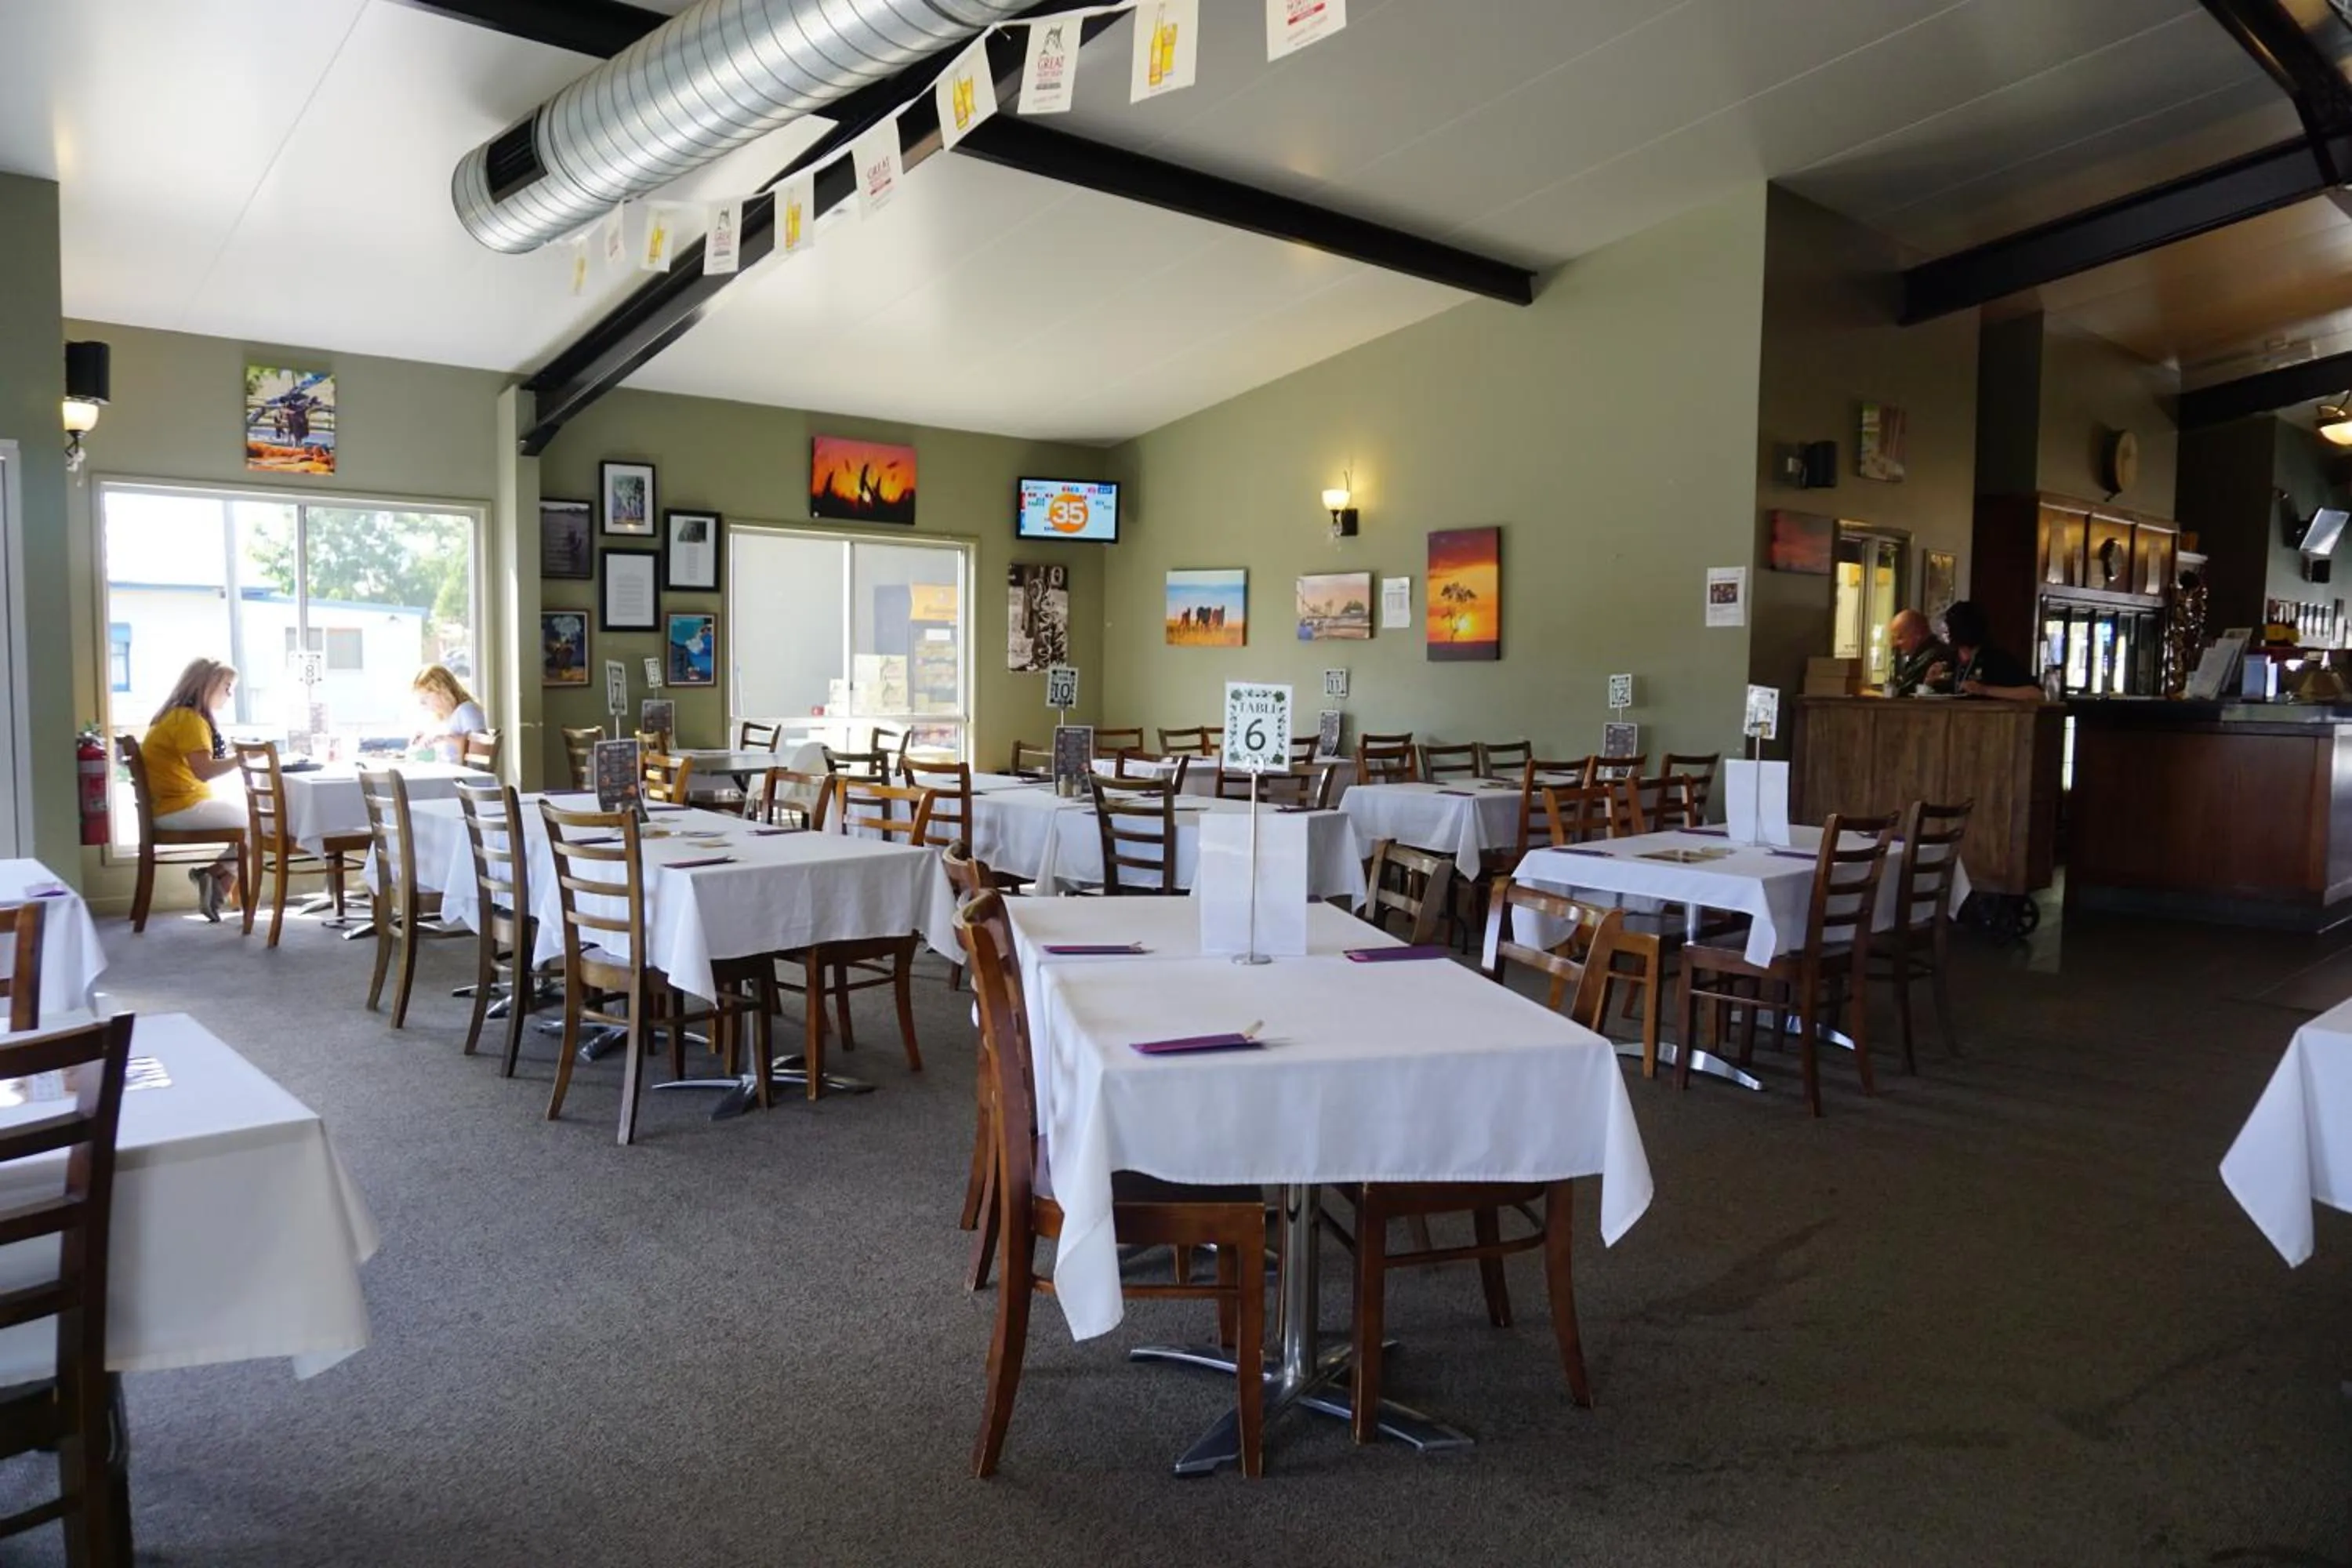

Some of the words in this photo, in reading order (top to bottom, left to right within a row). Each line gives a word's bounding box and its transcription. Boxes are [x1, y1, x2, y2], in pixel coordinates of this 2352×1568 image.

[1053, 501, 1085, 524] 35
[305, 664, 314, 677] 8
[1053, 683, 1070, 699] 10
[1240, 702, 1276, 714] TABLE
[1245, 718, 1266, 751] 6
